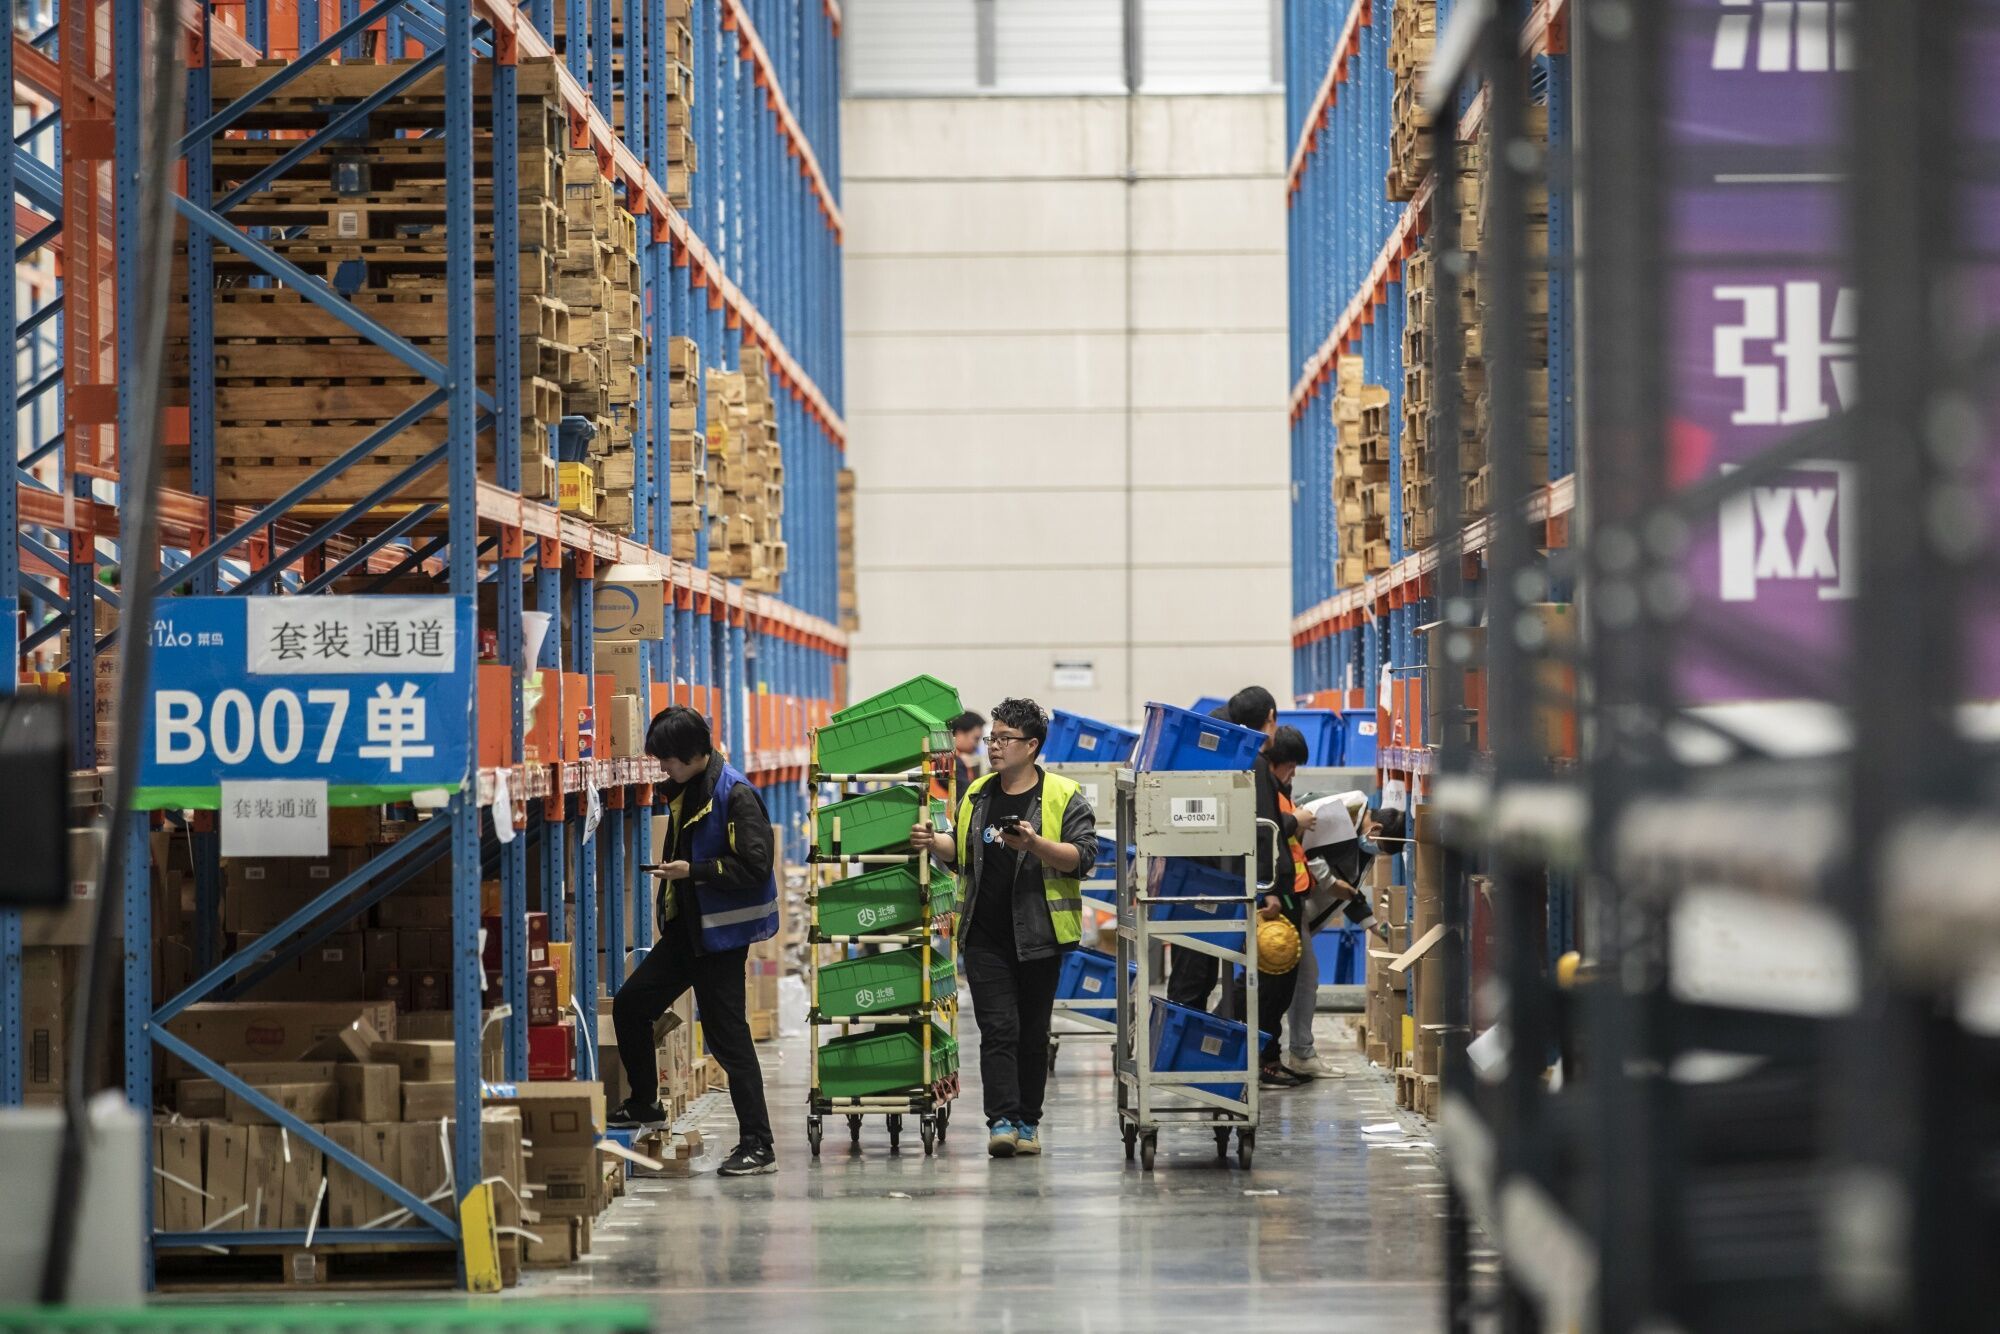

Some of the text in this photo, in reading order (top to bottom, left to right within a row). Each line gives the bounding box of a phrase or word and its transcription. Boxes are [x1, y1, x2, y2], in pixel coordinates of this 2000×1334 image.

[270, 619, 444, 660] 套装 通道
[155, 681, 435, 773] B007单
[232, 798, 318, 819] 套装通道
[1173, 813, 1216, 822] CA-010074
